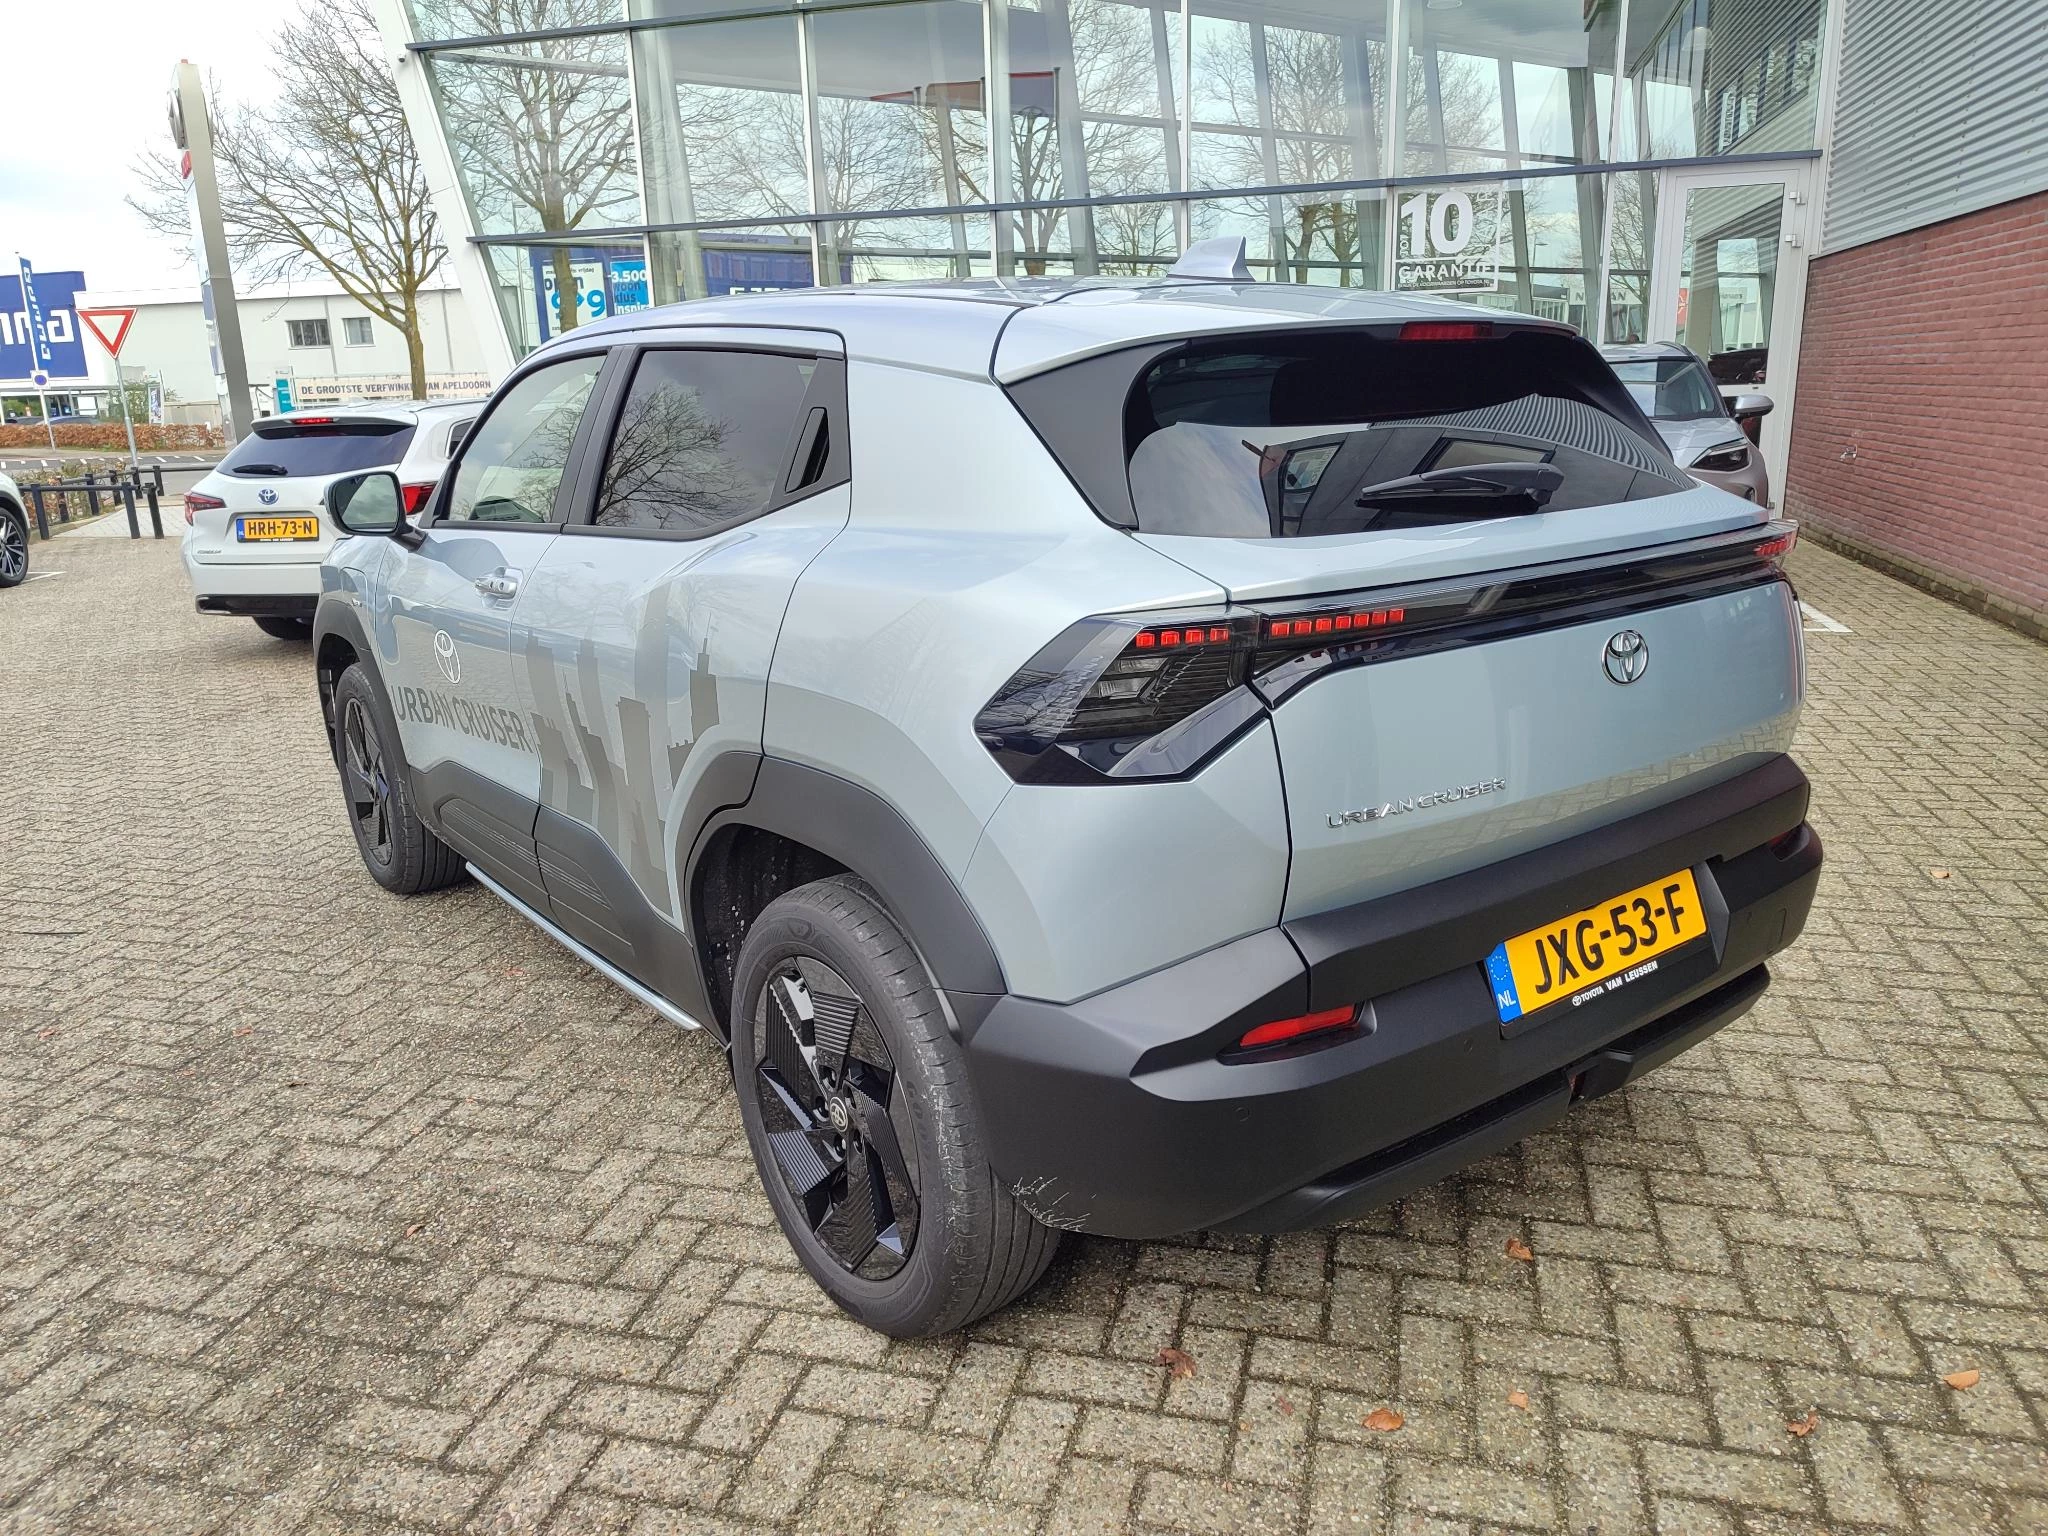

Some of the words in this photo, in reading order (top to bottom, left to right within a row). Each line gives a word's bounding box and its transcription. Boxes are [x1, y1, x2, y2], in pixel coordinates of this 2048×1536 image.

[1401, 191, 1473, 256] 10
[1399, 263, 1491, 279] GARANTIE
[301, 386, 314, 395] DE
[316, 384, 363, 395] GROOTSTE
[442, 380, 491, 390] APELDOORN
[248, 520, 313, 537] HRH-73-N
[390, 685, 457, 730] URBAN
[452, 695, 534, 754] CRUISER
[1325, 796, 1414, 829] URBAN
[1417, 776, 1506, 809] CRUISER
[1534, 883, 1685, 995] JXG-53-F
[1497, 990, 1517, 1009] NL
[1580, 985, 1604, 1002] TOYOTA
[1605, 976, 1623, 991] VAN
[1624, 960, 1659, 983] LEUSSEN
